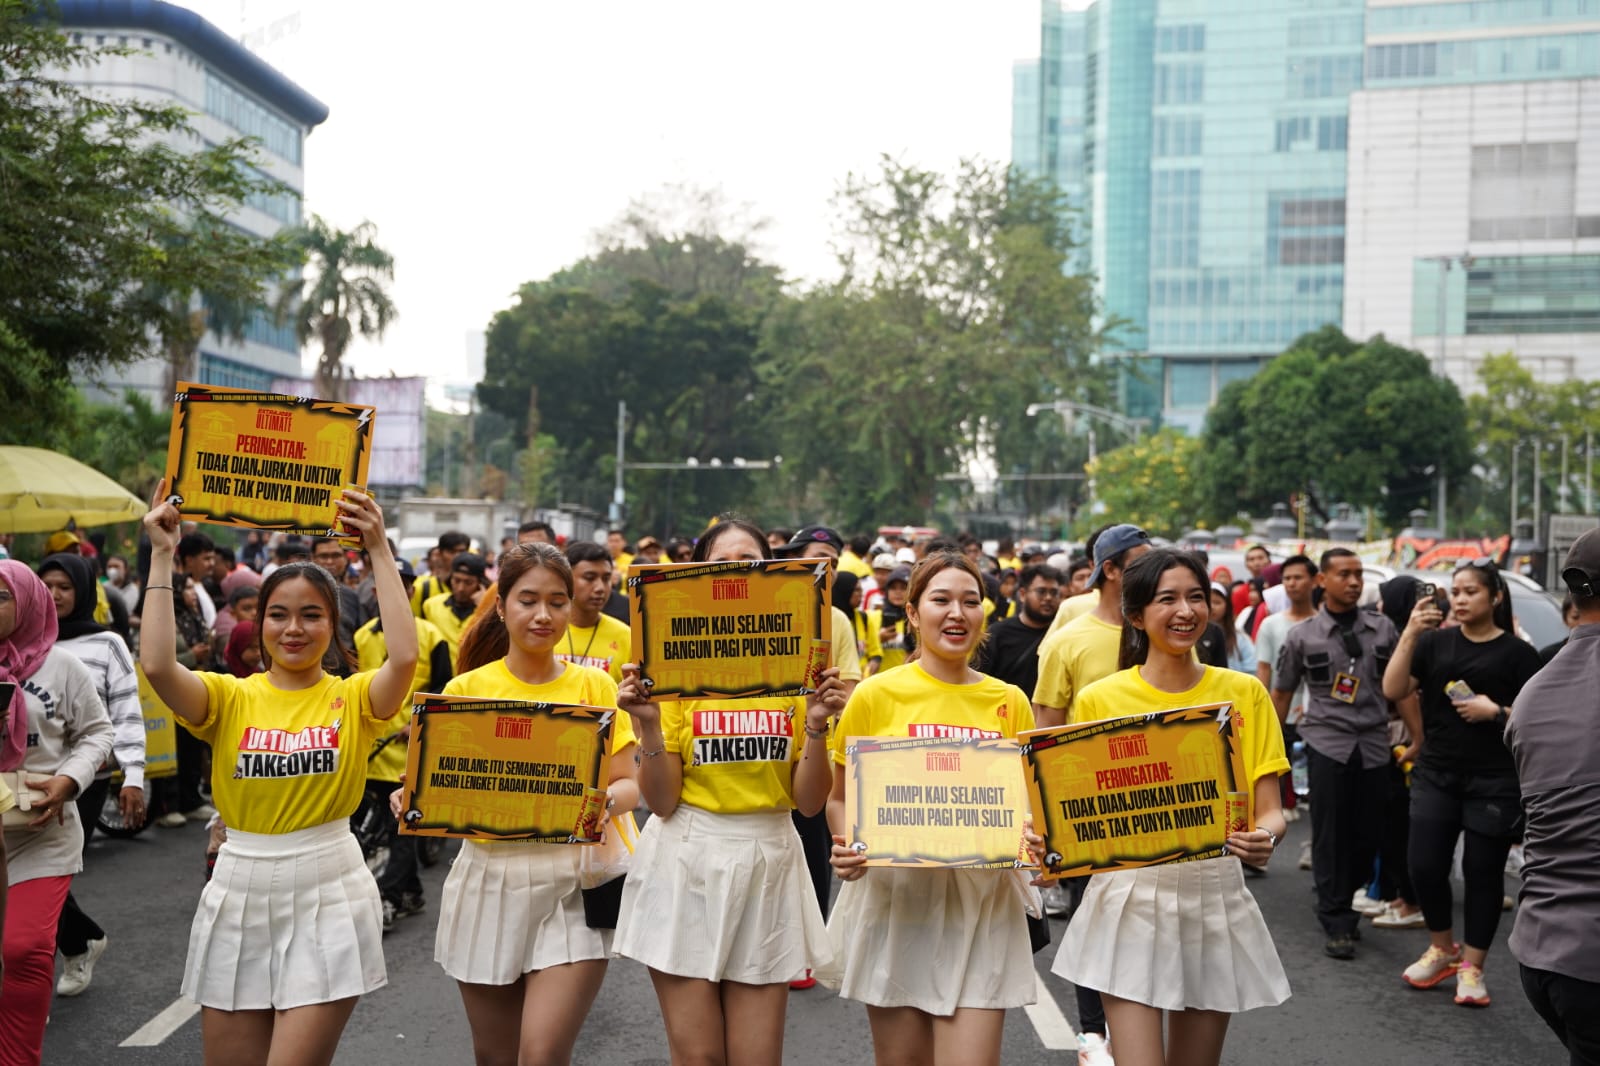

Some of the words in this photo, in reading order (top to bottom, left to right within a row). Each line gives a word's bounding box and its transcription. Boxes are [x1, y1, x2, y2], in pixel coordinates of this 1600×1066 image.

[256, 413, 292, 432] ULTIMATE
[236, 434, 307, 460] PERINGATAN:
[197, 452, 229, 473] TIDAK
[231, 456, 302, 480] DIANJURKAN
[304, 465, 342, 487] UNTUK
[202, 475, 231, 495] YANG
[233, 478, 255, 498] TAK
[257, 481, 292, 502] PUNYA
[294, 486, 331, 507] MIMPI
[712, 583, 749, 600] ULTIMATE
[671, 616, 709, 636] MIMPI
[711, 615, 735, 635] KAU
[737, 613, 793, 634] SELANGIT
[663, 639, 712, 660] BANGUN
[714, 638, 740, 658] PAGI
[742, 637, 766, 657] PUN
[768, 636, 802, 656] SULIT
[495, 721, 533, 740] ULTIMATE
[701, 711, 788, 735] ULTIMATE
[915, 725, 1000, 738] ULTIMA
[247, 727, 332, 753] ULTIMATE
[699, 736, 788, 763] TAKEOVER
[1109, 738, 1150, 760] ULTIMATE
[242, 749, 334, 777] TAKEOVER
[438, 756, 456, 771] KAU
[457, 758, 488, 774] BILANG
[490, 760, 503, 774] ITU
[505, 761, 556, 779] SEMANGAT?
[558, 764, 577, 783] BAH,
[926, 757, 960, 771] ULTIMATE
[430, 773, 459, 789] MASIH
[460, 775, 497, 792] LENGKET
[498, 778, 528, 794] BADAN
[528, 780, 546, 795] KAU
[547, 781, 584, 797] DIKASUR
[1096, 762, 1173, 791] PERINGATAN:
[885, 785, 923, 803] MIMPI
[925, 786, 948, 804] KAU
[950, 786, 1005, 805] SELANGIT
[1060, 799, 1098, 820] TIDAK
[1099, 785, 1176, 814] DIANJURKAN
[1175, 780, 1220, 803] UNTUK
[877, 807, 925, 826] BANGUN
[927, 808, 953, 826] PAGI
[955, 808, 979, 827] PUN
[982, 809, 1014, 828] SULIT
[1073, 821, 1107, 843] YANG
[1107, 818, 1130, 838] TAK
[1132, 811, 1172, 835] PUNYA
[1174, 805, 1214, 828] MIMPI
